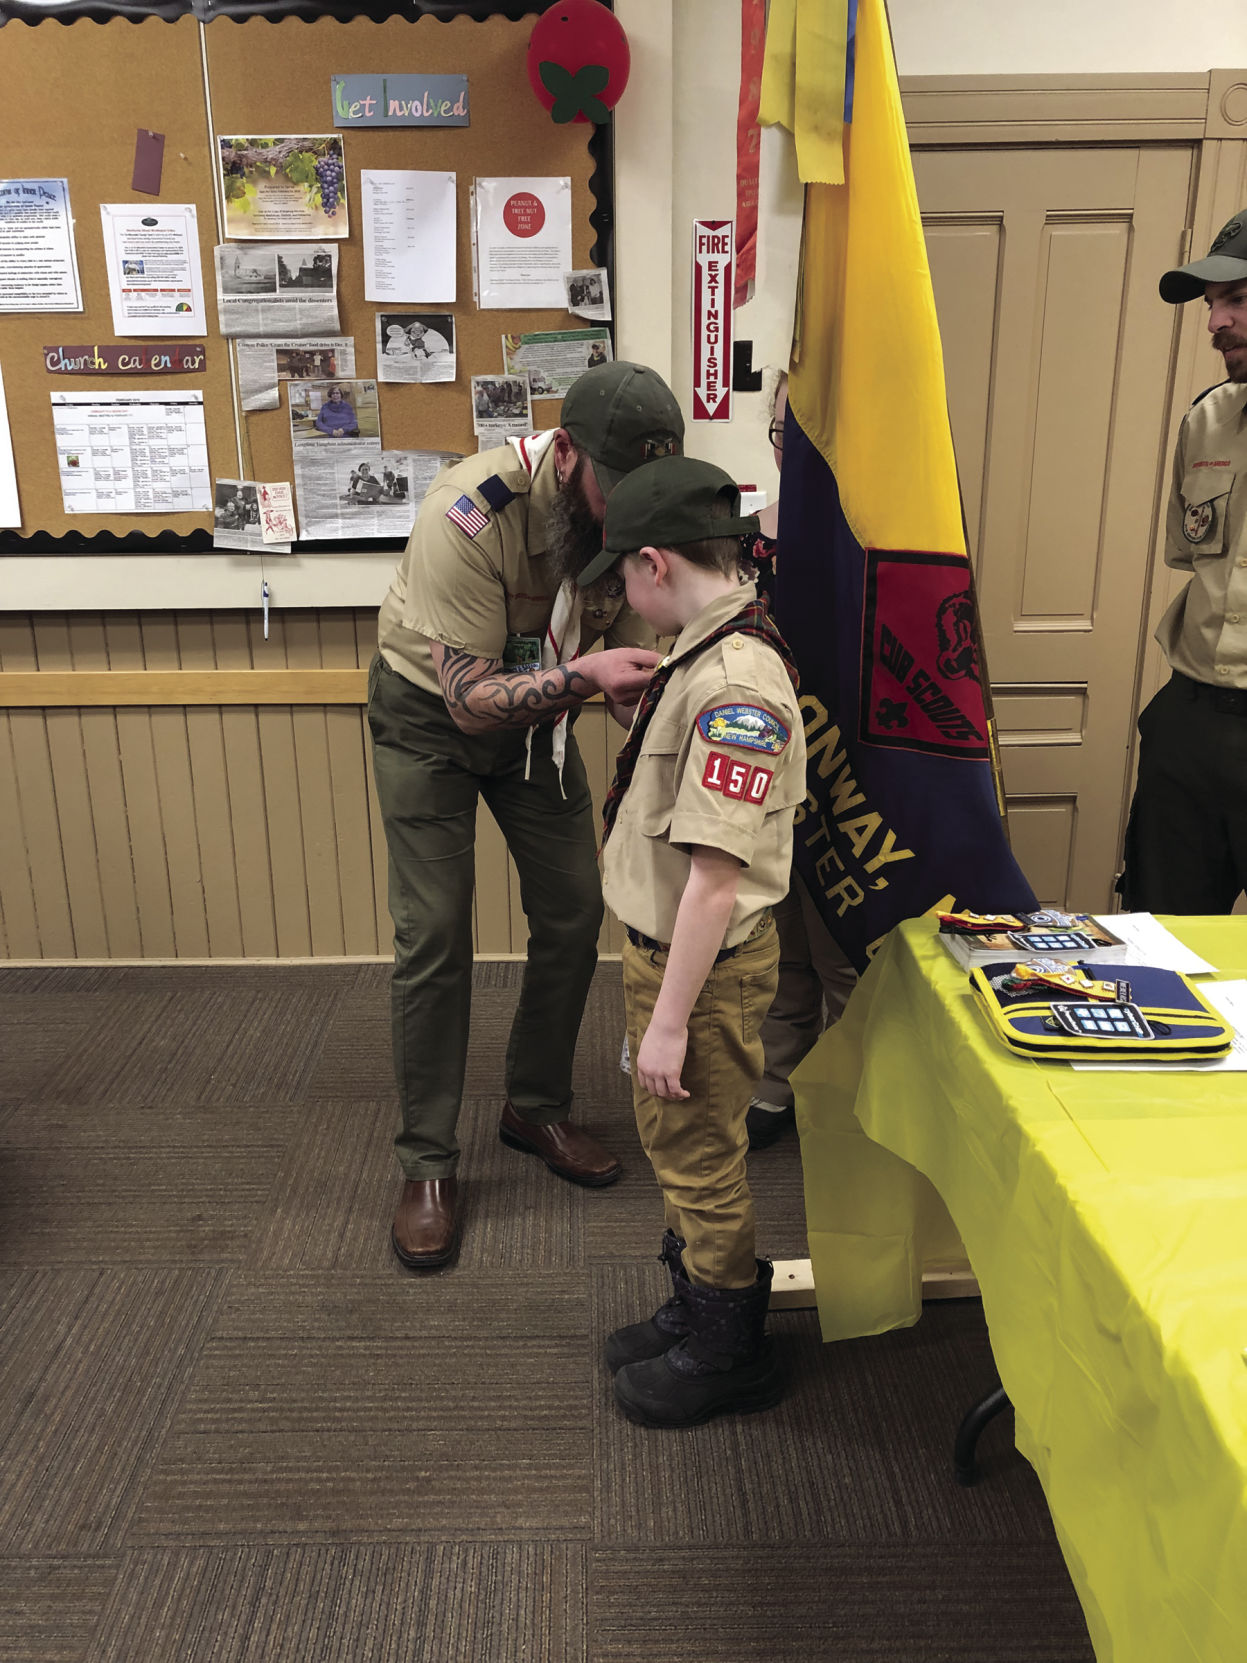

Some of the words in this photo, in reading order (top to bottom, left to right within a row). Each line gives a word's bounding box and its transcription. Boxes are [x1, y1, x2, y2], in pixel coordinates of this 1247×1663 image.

[335, 80, 376, 119] Get
[383, 78, 467, 117] Involved
[698, 234, 730, 255] FIRE
[705, 260, 720, 404] EXTINGUISHER
[46, 345, 109, 371] Church
[878, 622, 914, 684] CUB
[905, 668, 984, 743] SCOUTS
[714, 708, 735, 718] DANIEL
[736, 707, 761, 717] WEBSTER
[762, 714, 780, 733] COUNCIL
[725, 732, 737, 740] NEW
[707, 758, 768, 799] 150
[798, 694, 916, 891] ONWAY,
